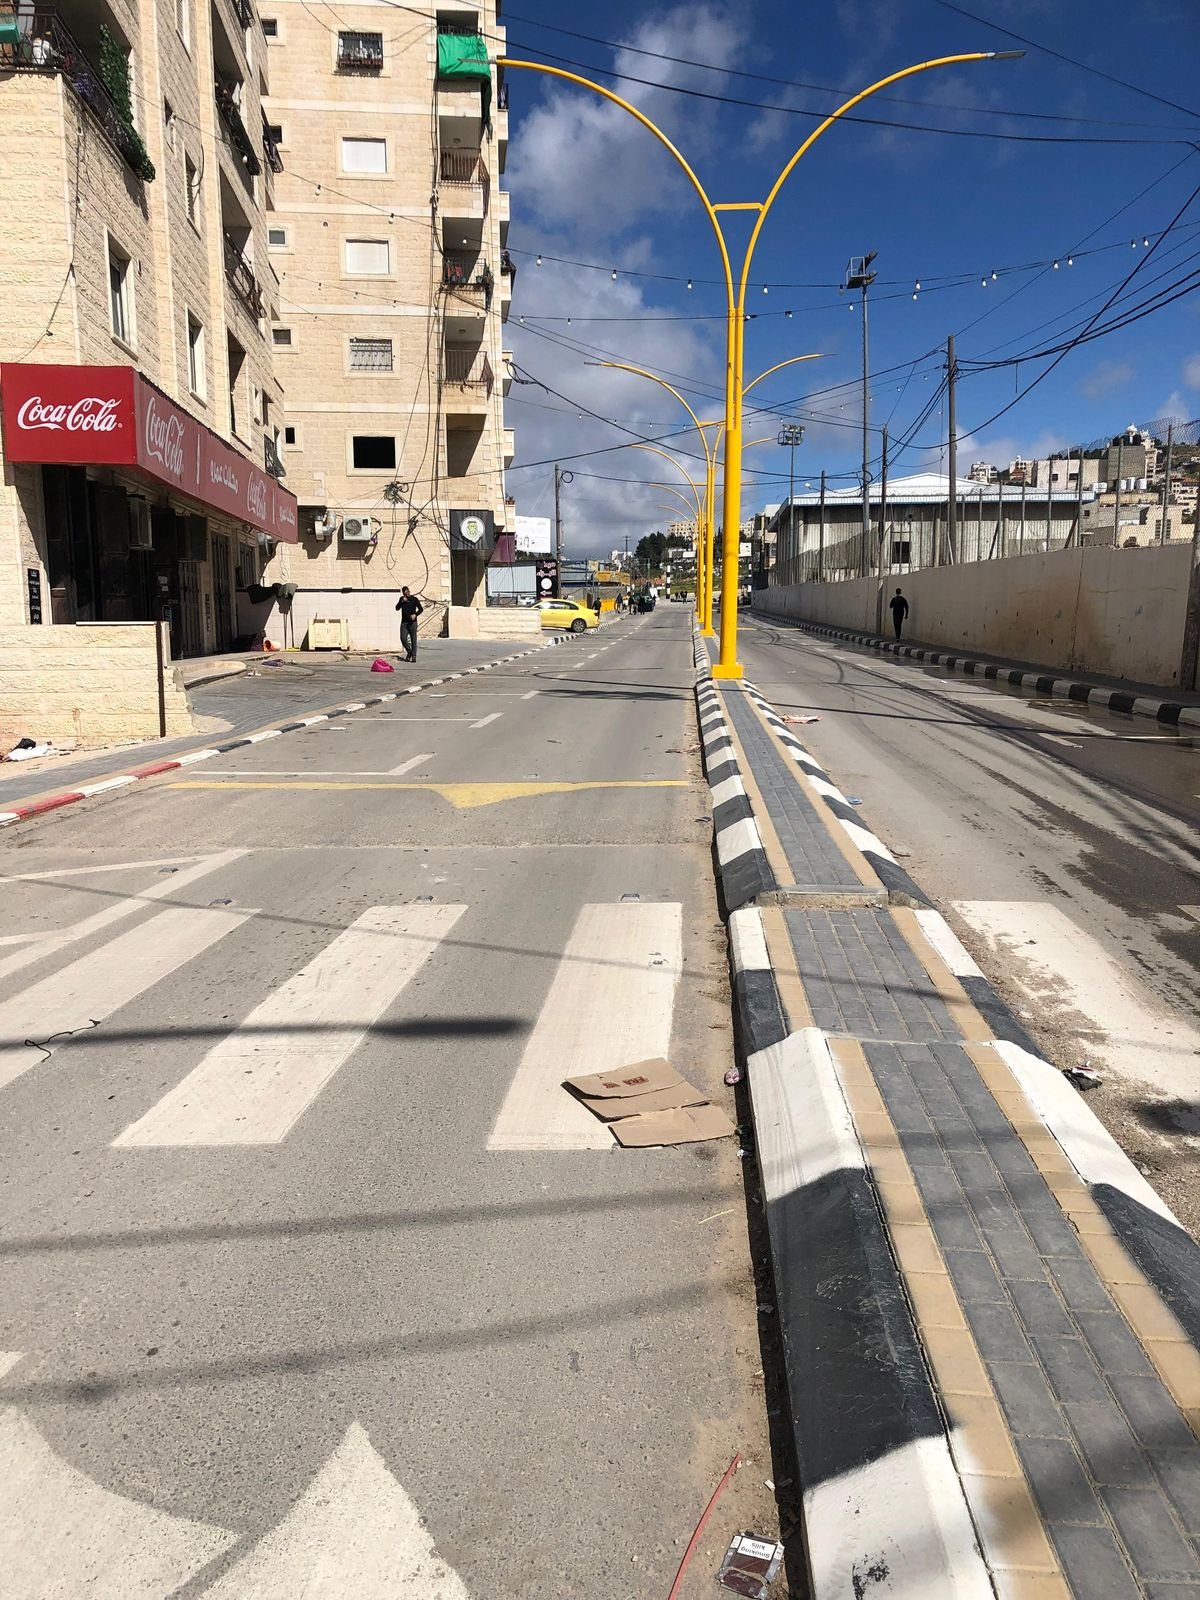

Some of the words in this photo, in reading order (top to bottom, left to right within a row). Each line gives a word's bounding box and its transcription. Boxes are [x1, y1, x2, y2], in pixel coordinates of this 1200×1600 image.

[17, 396, 122, 432] Coca-Cola
[146, 397, 185, 475] Coca-Cola
[740, 1546, 771, 1559] Smoking
[751, 1542, 766, 1550] kills
